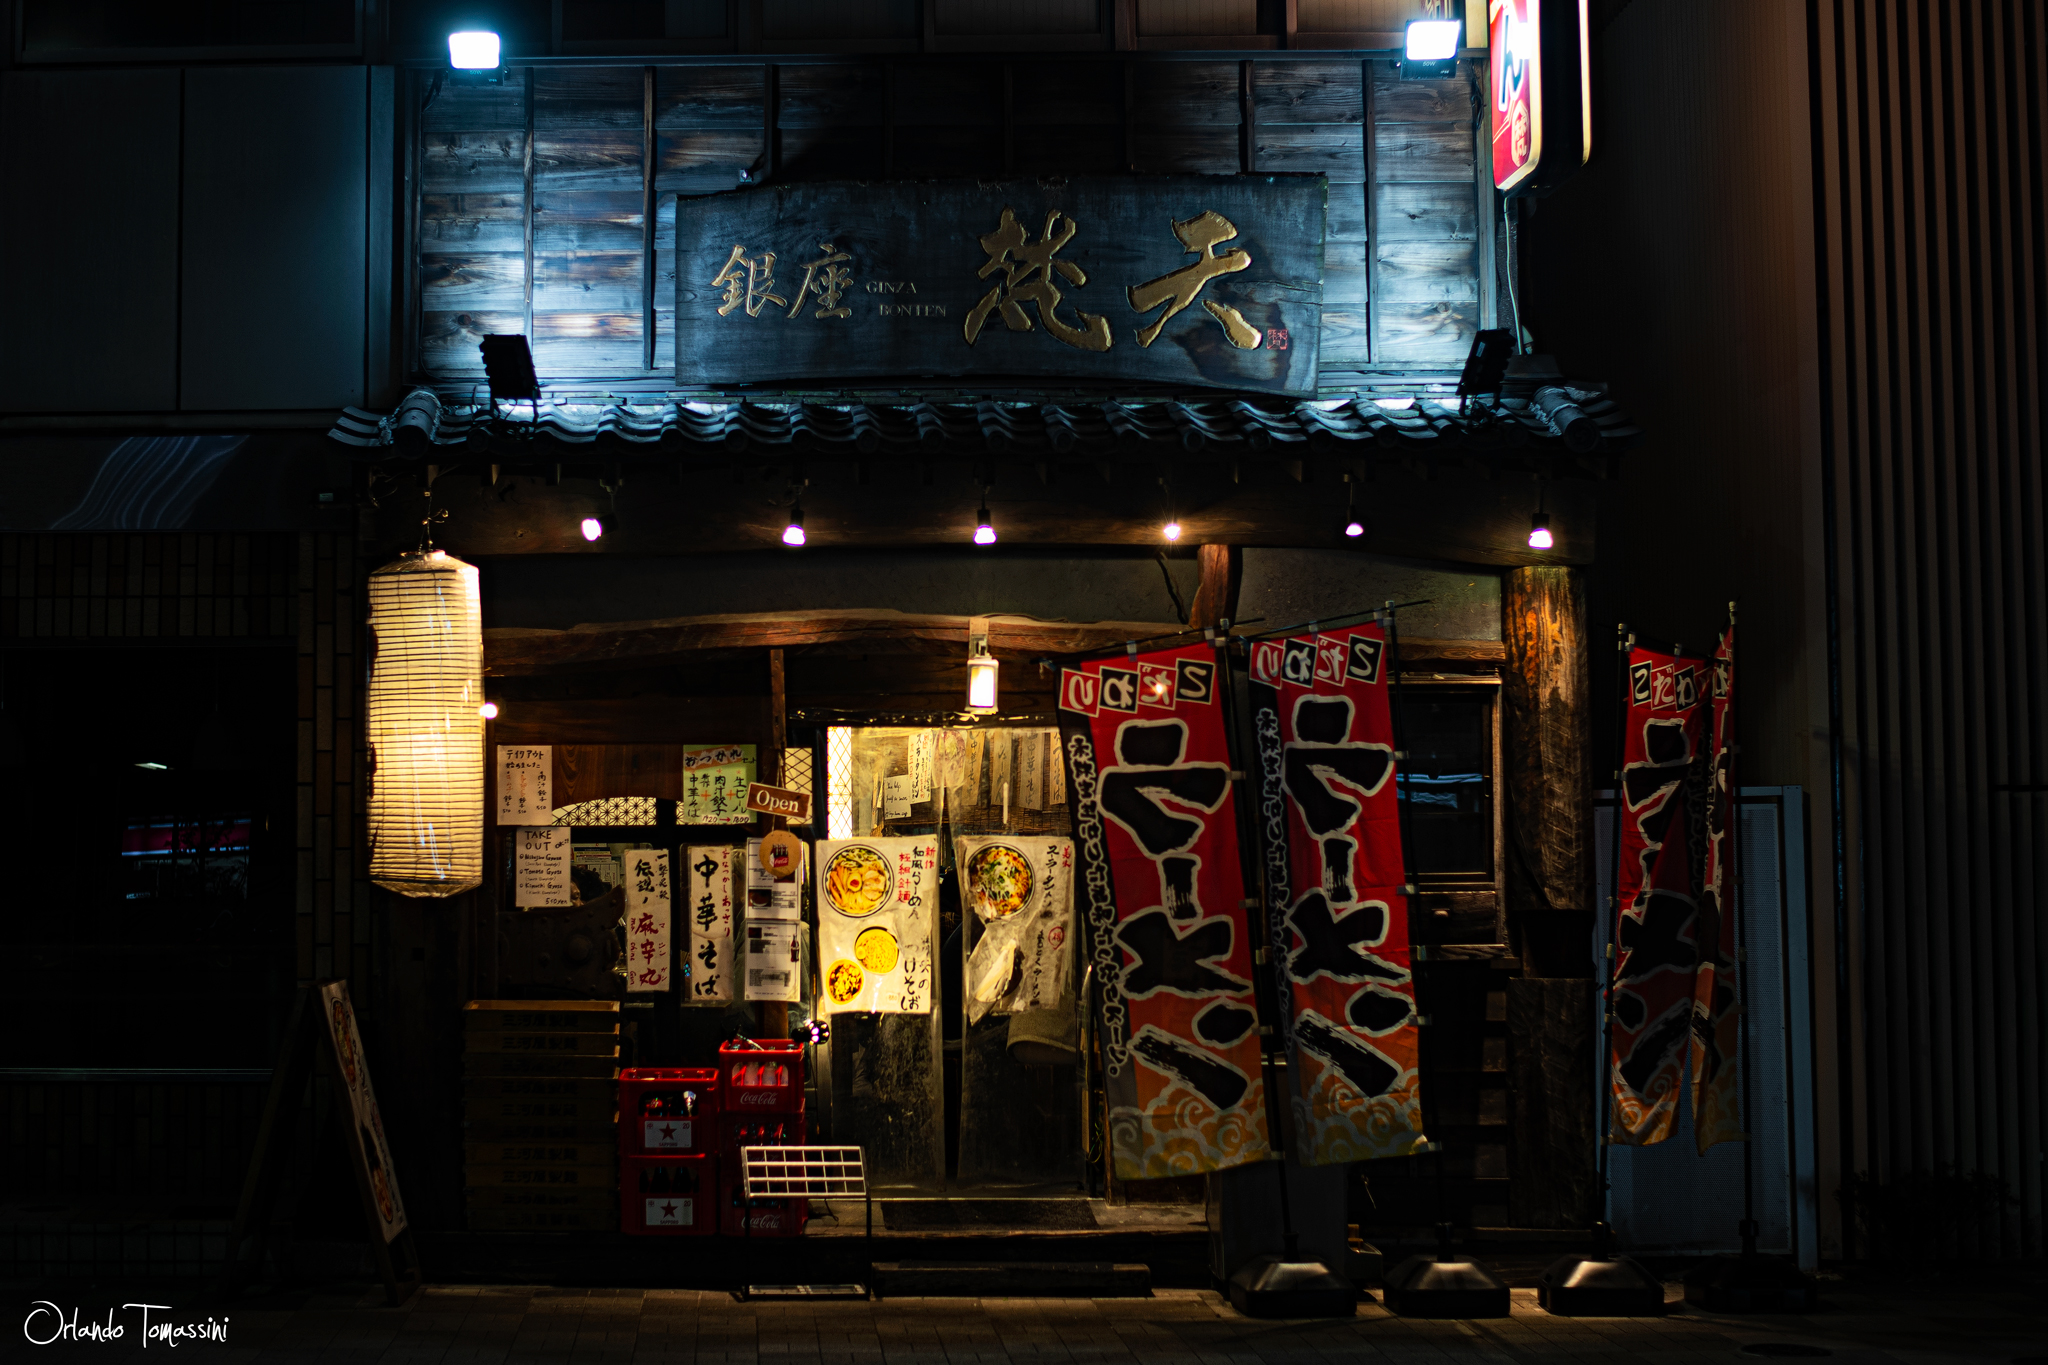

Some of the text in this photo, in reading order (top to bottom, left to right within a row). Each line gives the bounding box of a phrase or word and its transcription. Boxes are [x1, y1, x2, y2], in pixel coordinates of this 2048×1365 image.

[710, 244, 853, 319] 銀座
[865, 281, 917, 294] GINZA
[879, 303, 947, 317] BONTEN
[506, 750, 544, 760] テイクアウト
[685, 748, 742, 766] おつかれ
[688, 773, 700, 817] 中華そば
[731, 776, 748, 814] 生ビール
[756, 790, 799, 812] Open
[525, 830, 552, 840] TAKE
[526, 842, 551, 850] OUT
[925, 846, 936, 870] 新作
[908, 846, 925, 920] 和風らーめん
[694, 854, 720, 996] 中華そば
